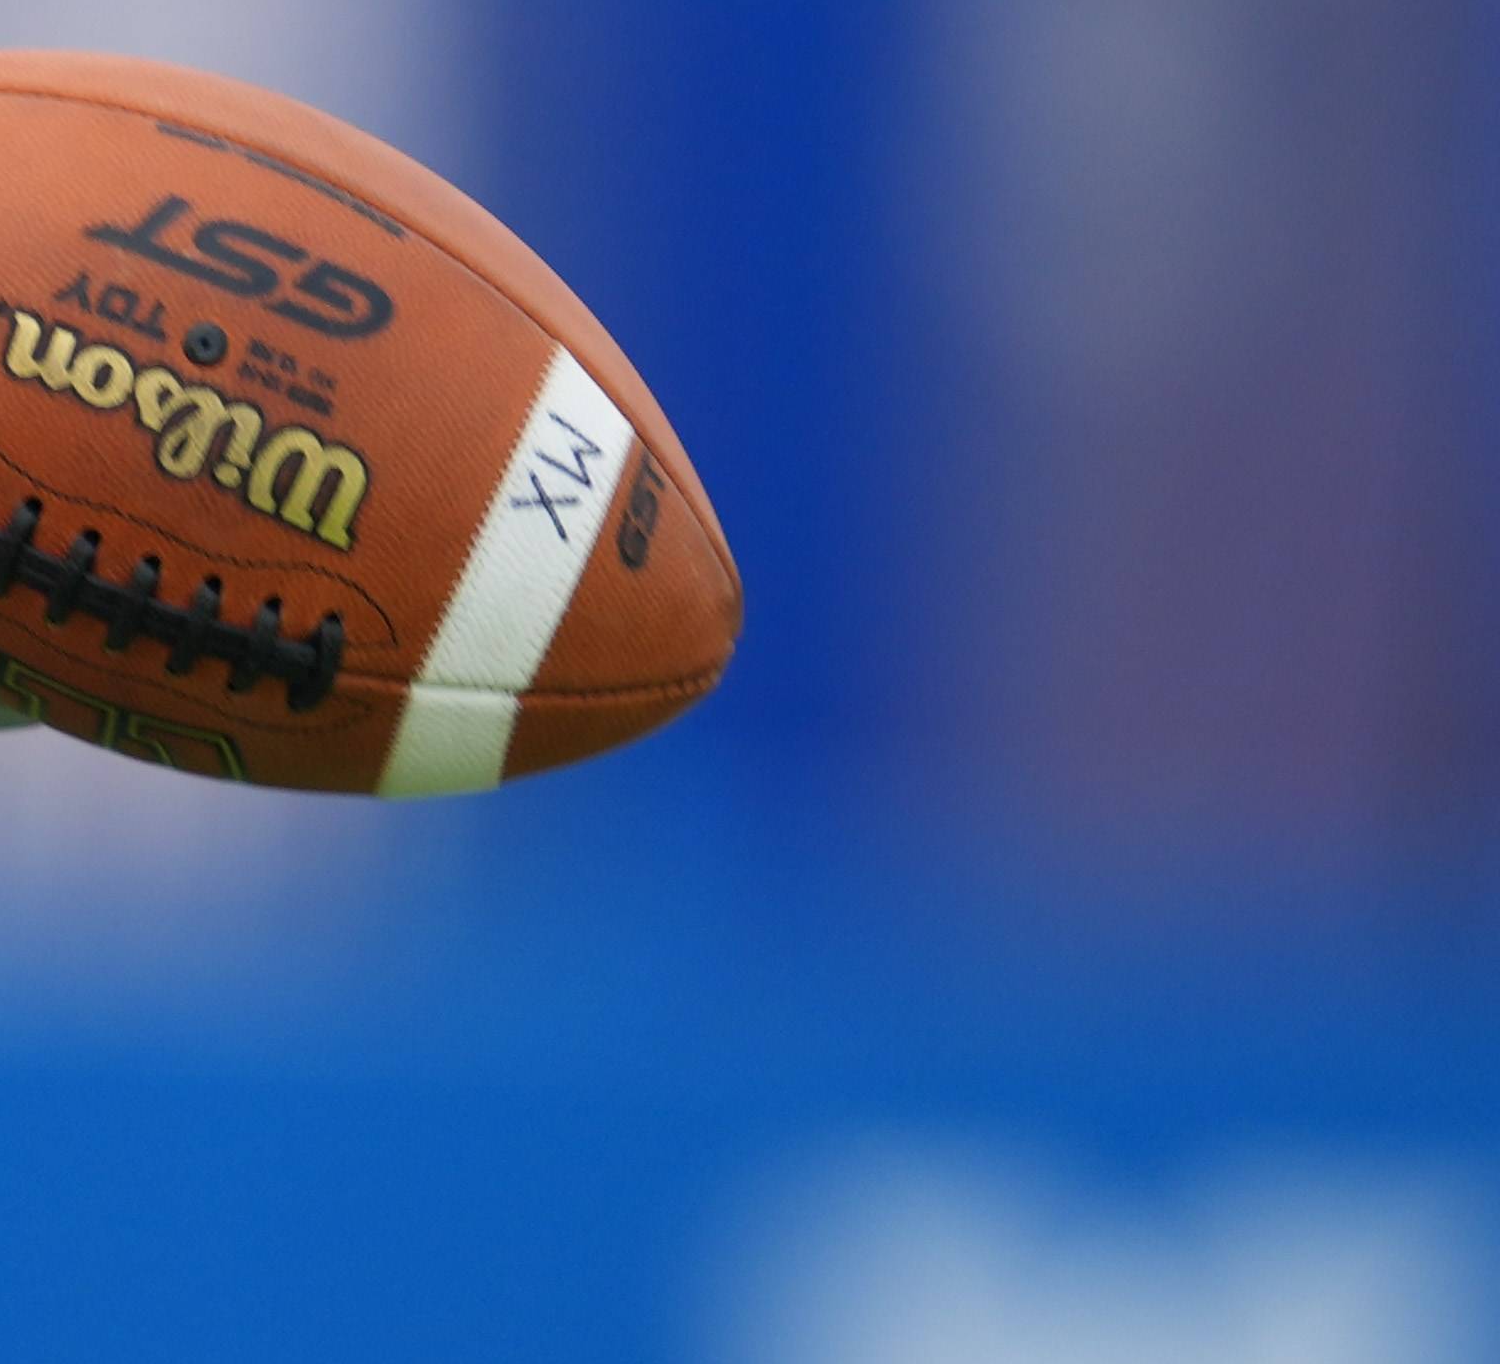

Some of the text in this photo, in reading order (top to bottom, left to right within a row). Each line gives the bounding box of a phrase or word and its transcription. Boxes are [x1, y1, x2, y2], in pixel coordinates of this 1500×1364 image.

[84, 195, 395, 340] GST
[1, 309, 371, 553] Wilson
[510, 411, 603, 541] MX
